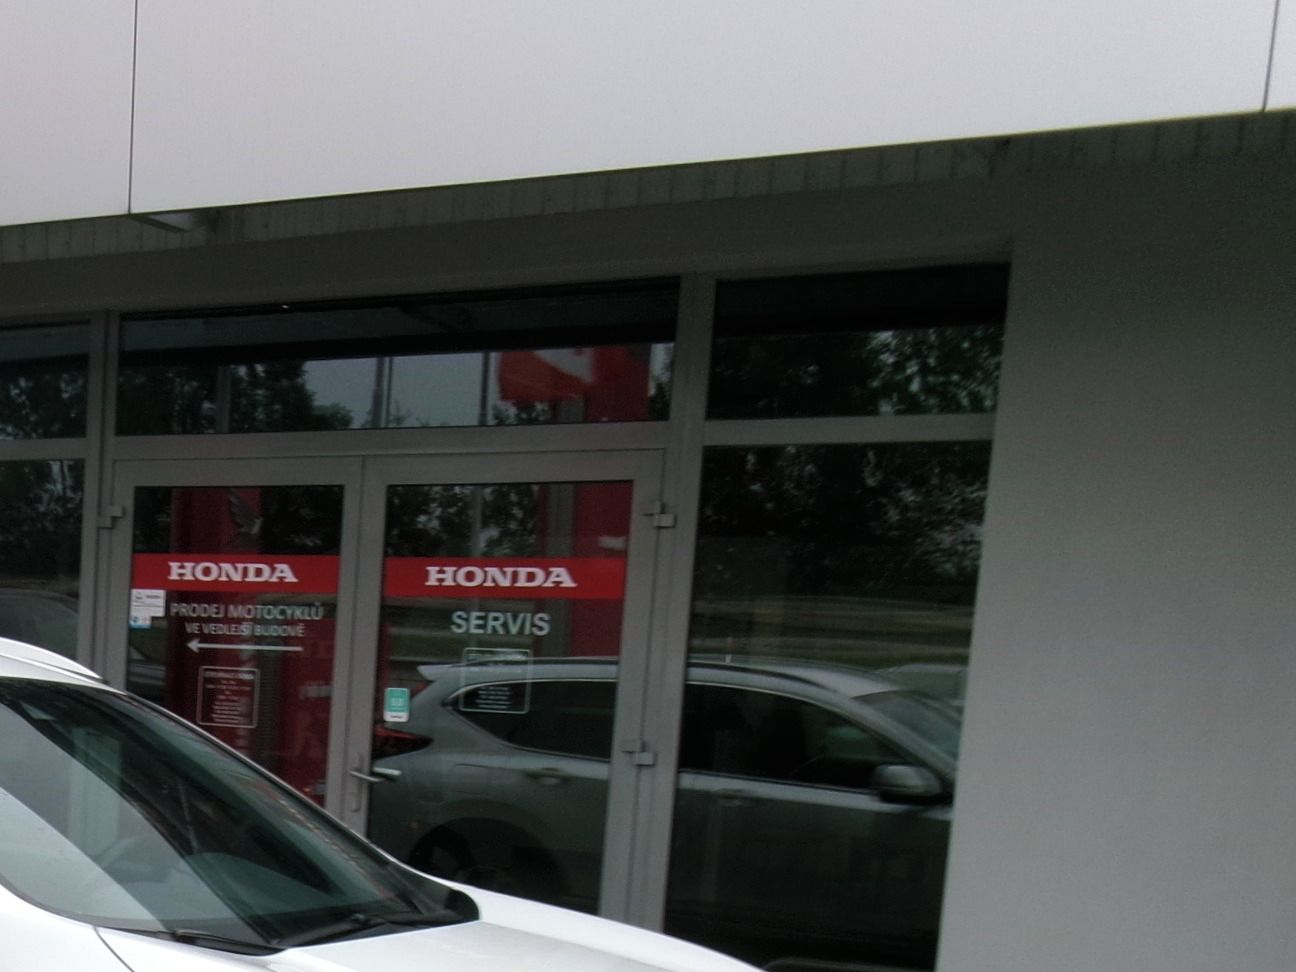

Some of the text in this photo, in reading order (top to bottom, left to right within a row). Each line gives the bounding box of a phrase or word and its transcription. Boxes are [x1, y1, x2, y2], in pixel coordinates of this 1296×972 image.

[167, 561, 299, 582] HONDA
[424, 566, 578, 587] HONDA
[170, 602, 324, 620] PRODEJ MOTOCYKLŮ
[185, 622, 200, 634] VE
[451, 611, 551, 636] SERVIS
